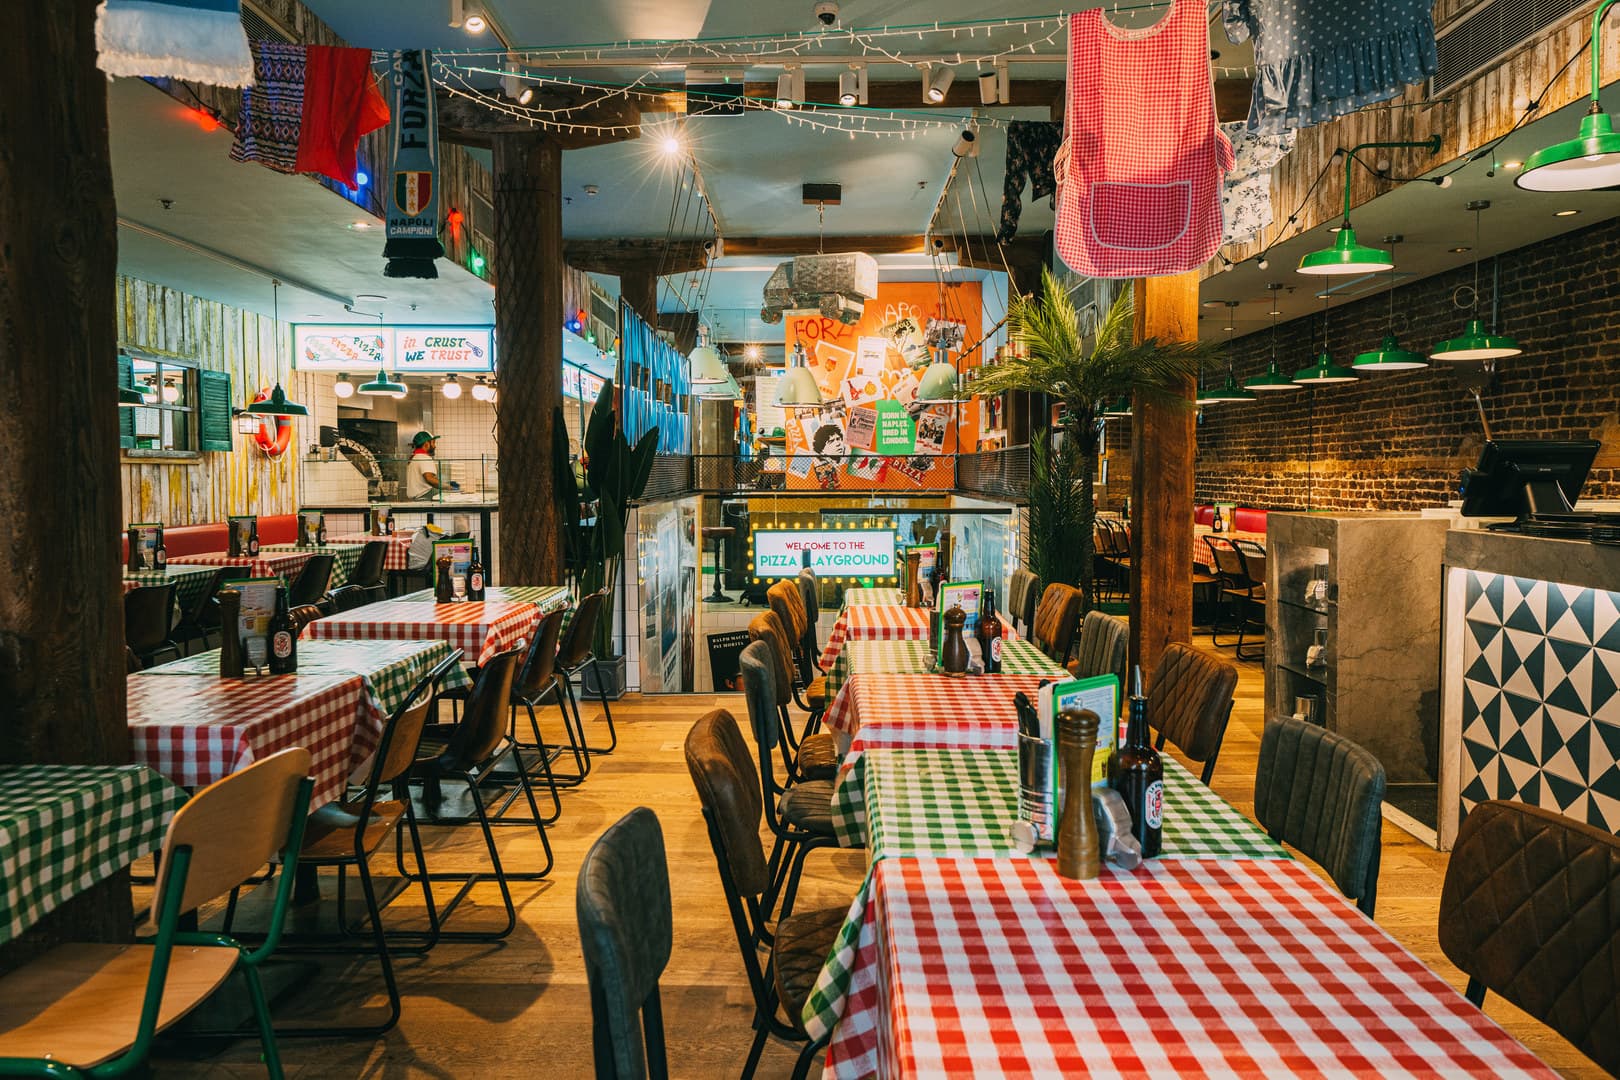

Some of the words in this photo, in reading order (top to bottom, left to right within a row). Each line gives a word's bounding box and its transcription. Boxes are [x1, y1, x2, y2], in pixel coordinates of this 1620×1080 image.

[390, 219, 434, 227] NAPOLI
[390, 227, 433, 235] CAMPIONI
[424, 337, 466, 348] CRUST
[405, 350, 426, 361] WE
[430, 350, 472, 361] TRUST
[785, 542, 831, 551] WELCOME
[833, 542, 847, 550] TO
[848, 541, 865, 550] THE
[760, 555, 798, 567] PIZZA
[801, 554, 890, 567] AYGROUND
